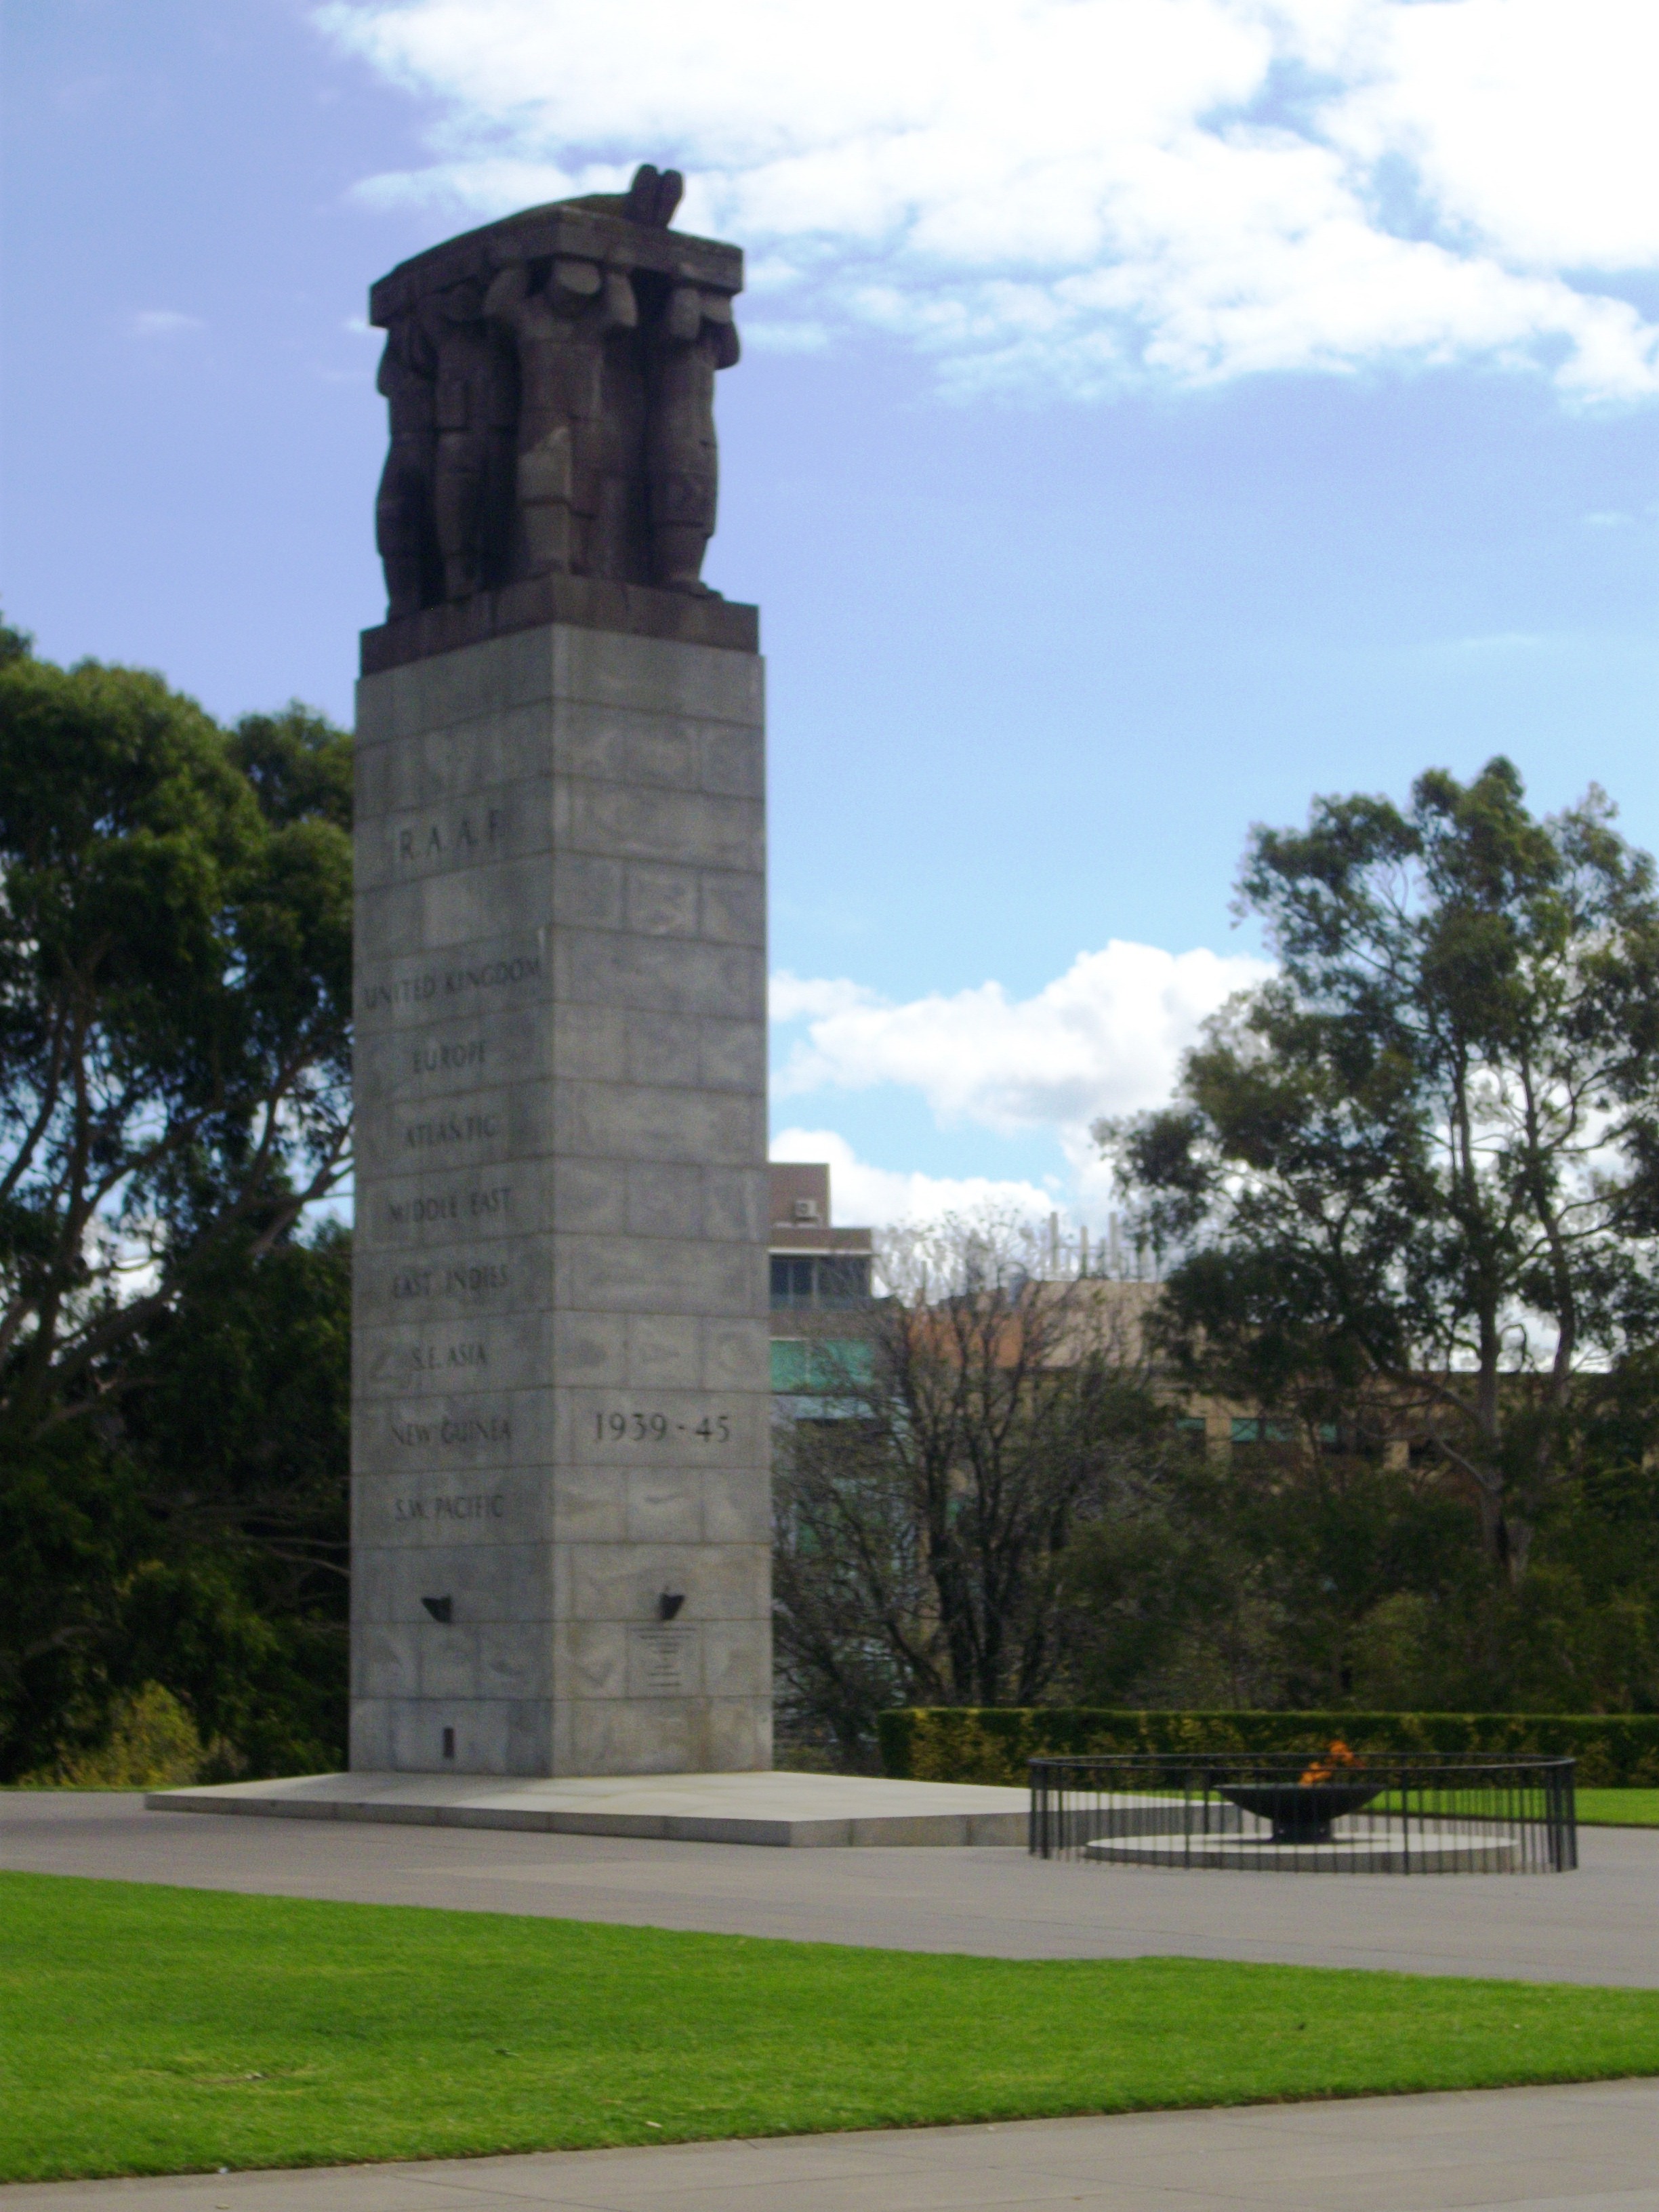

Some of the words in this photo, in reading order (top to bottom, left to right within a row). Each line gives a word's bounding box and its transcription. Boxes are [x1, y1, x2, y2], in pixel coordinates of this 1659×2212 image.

[364, 975, 436, 1010] UNITED
[445, 957, 541, 995] KINGDOM
[413, 1039, 487, 1074] EUROPE
[406, 1113, 498, 1148] ATLANTIC
[388, 1195, 459, 1224] MIDDLE
[470, 1186, 512, 1216] EAST
[392, 1271, 432, 1299] EAST
[445, 1263, 510, 1292] INDIES
[447, 1343, 489, 1368] ASIA
[390, 1422, 431, 1447] NEW
[441, 1416, 512, 1445] GUINEA
[434, 1493, 504, 1520] PACIFIC
